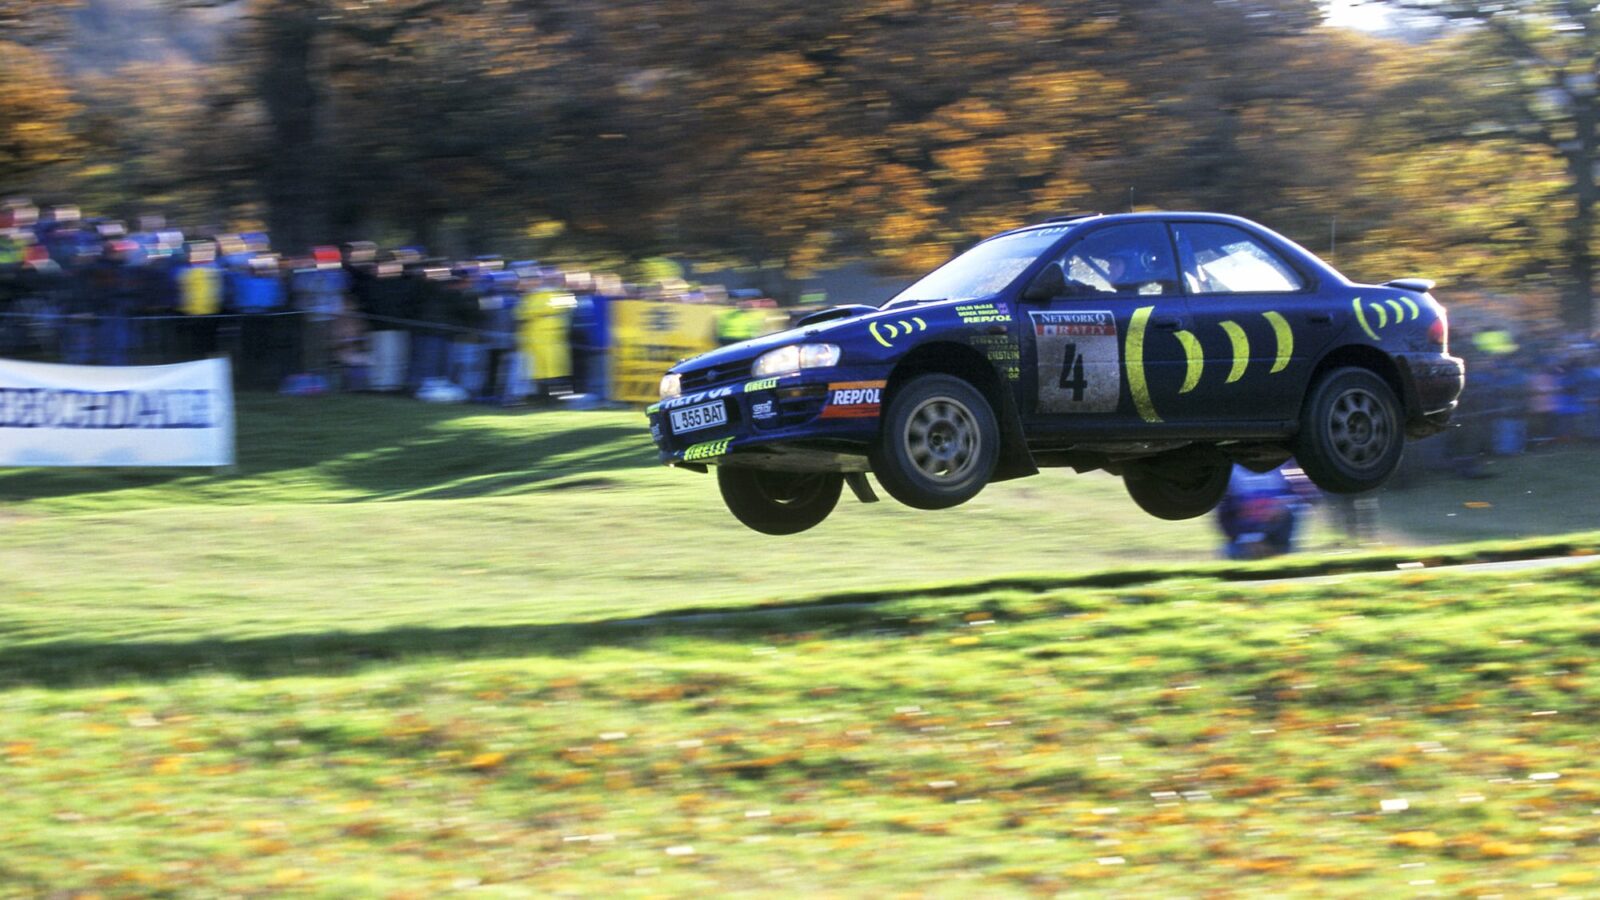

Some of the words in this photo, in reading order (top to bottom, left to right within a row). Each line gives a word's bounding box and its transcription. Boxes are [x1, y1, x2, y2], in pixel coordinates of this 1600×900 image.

[963, 314, 1012, 324] REPSOL
[1041, 313, 1095, 324] NETWORK
[1095, 313, 1106, 325] Q
[1059, 343, 1088, 402] 4
[744, 376, 781, 393] PIRELLI
[832, 389, 880, 405] REPSOL
[672, 414, 681, 431] L
[681, 409, 702, 428] 555
[702, 404, 724, 424] BAT
[683, 437, 733, 461] PIRELLI
